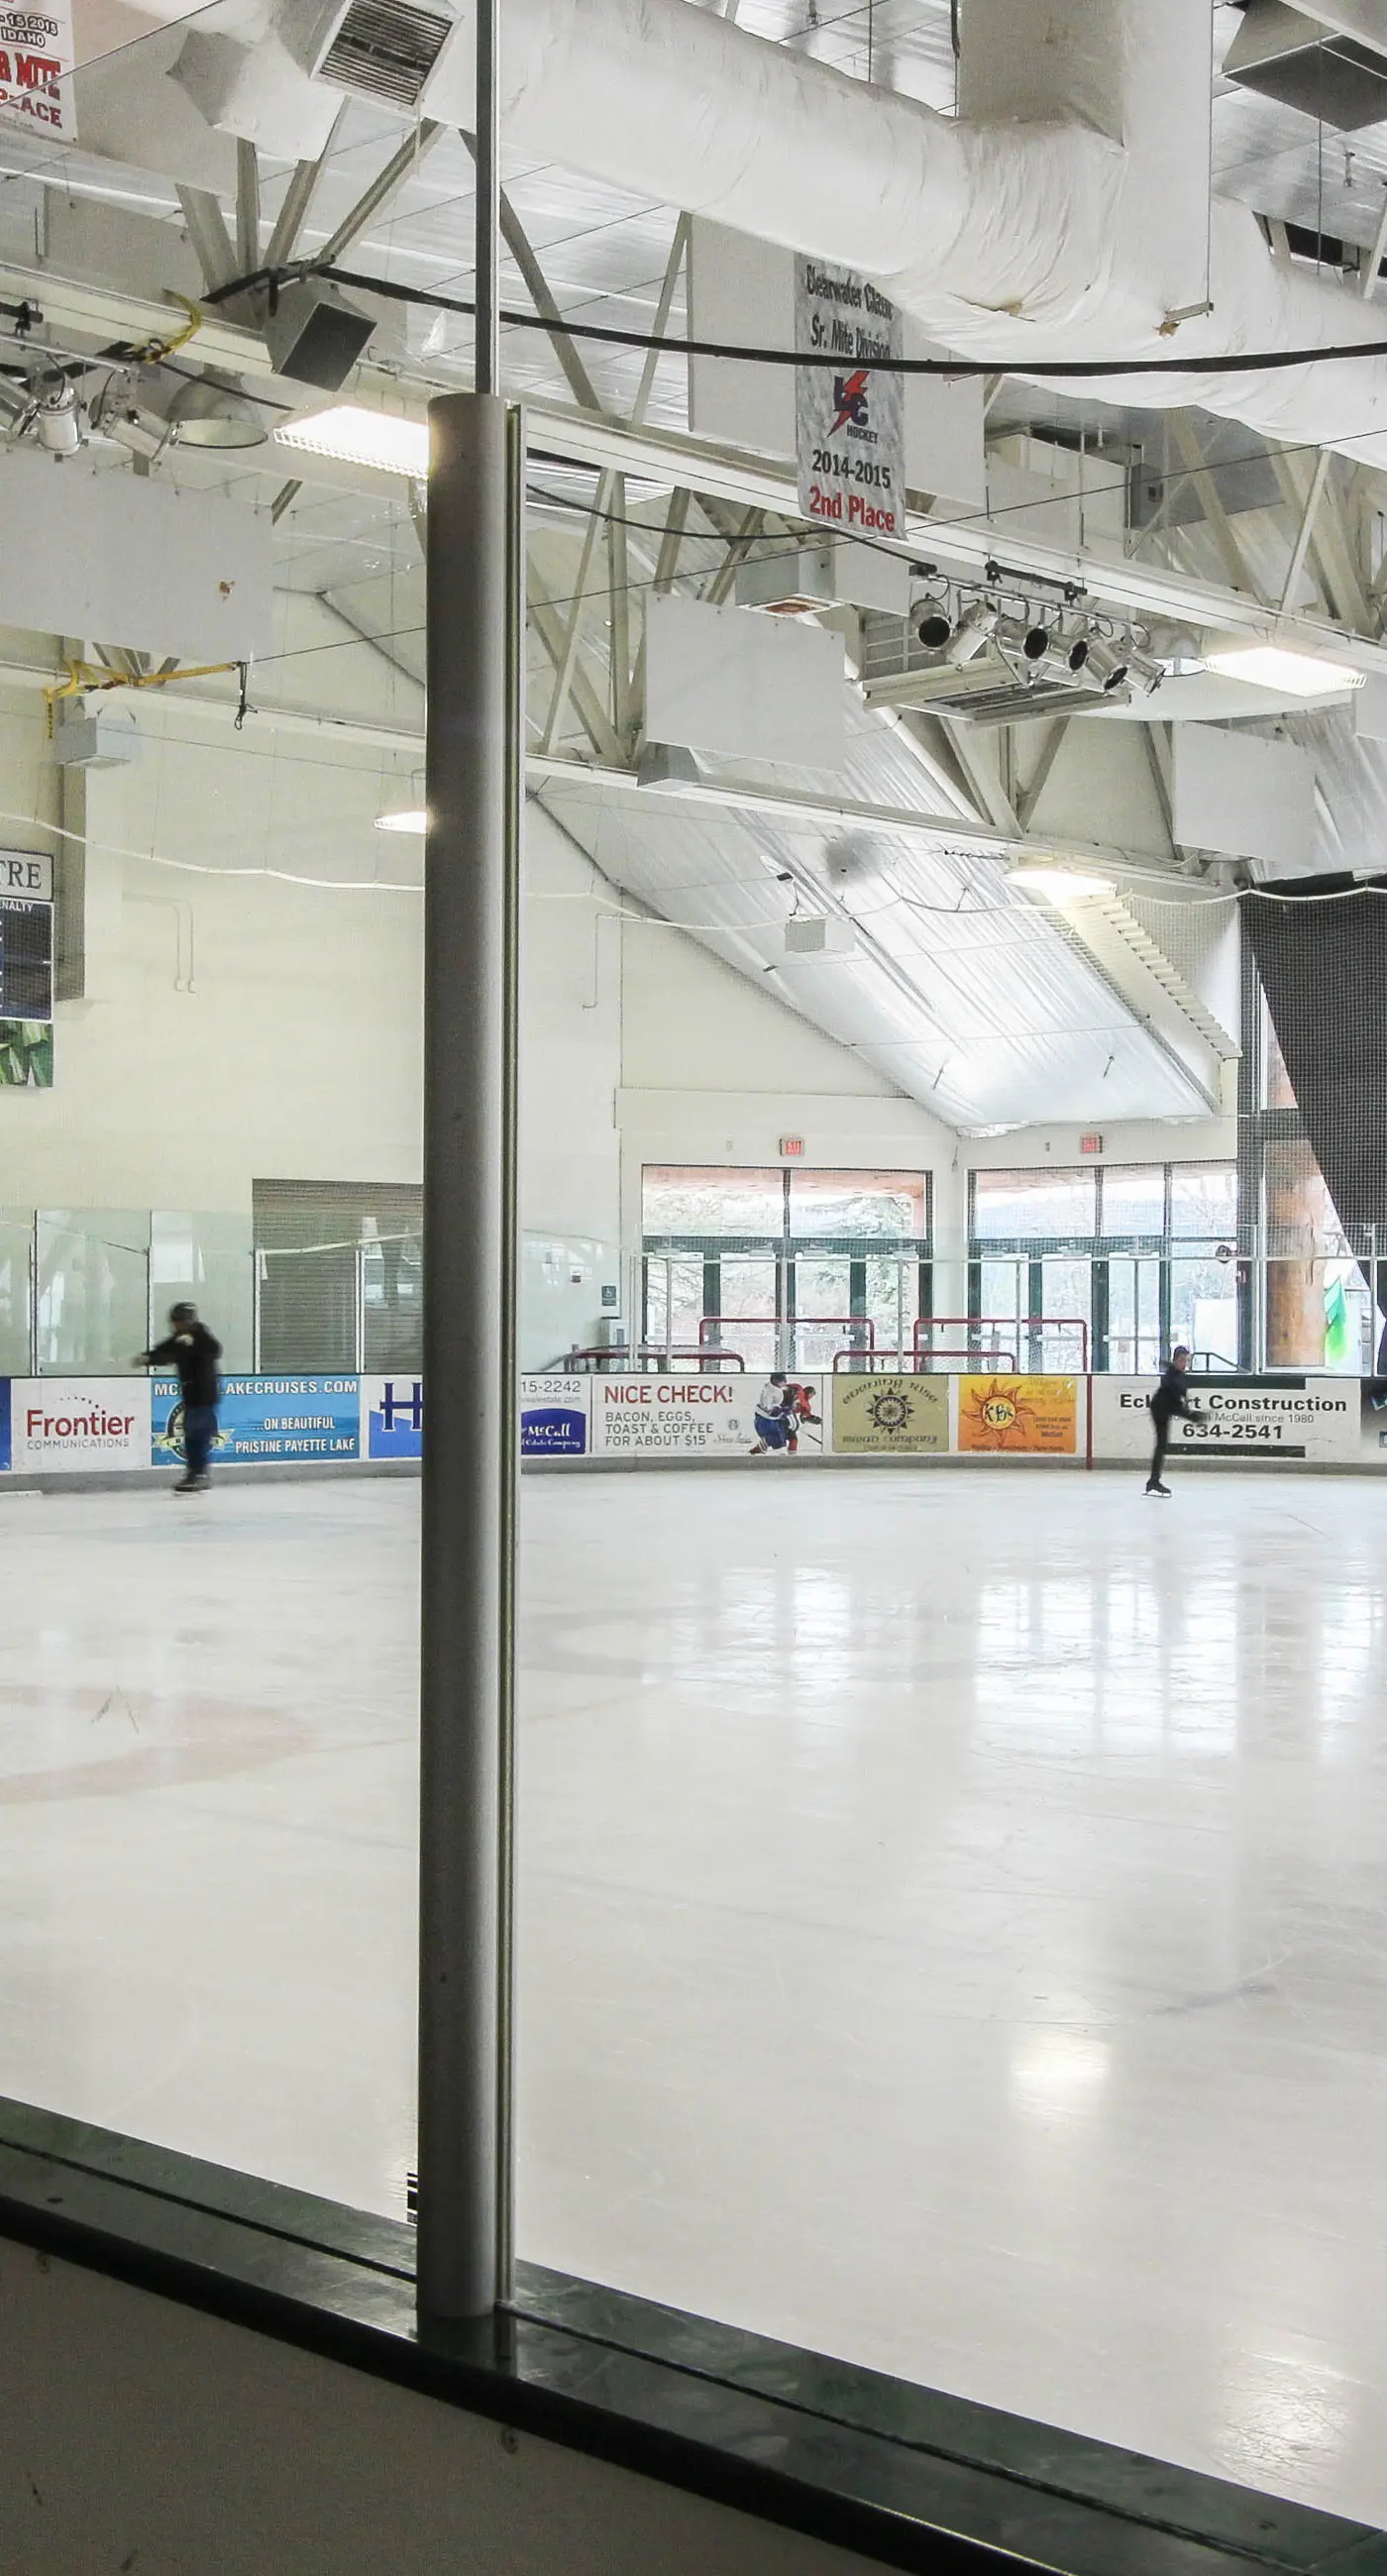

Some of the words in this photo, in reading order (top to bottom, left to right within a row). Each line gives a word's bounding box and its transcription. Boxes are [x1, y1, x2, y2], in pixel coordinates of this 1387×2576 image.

[28, 16, 57, 36] 2015
[1, 27, 46, 48] IDAHO
[811, 313, 827, 349] Sr.
[832, 319, 853, 356] Mite
[847, 424, 879, 444] HOCKEY
[812, 449, 891, 488] 2014-2015
[809, 484, 842, 519] 2nd
[848, 494, 895, 532] Place
[0, 900, 34, 912] NALTY
[604, 1385, 651, 1403] NICE
[657, 1385, 733, 1403] CHECK!
[1209, 1395, 1347, 1411] Construction
[27, 1409, 135, 1437] Frontier
[281, 1416, 335, 1430] BEAUTIFUL
[605, 1412, 654, 1423] BACON,
[658, 1412, 695, 1423] EGGS,
[1215, 1413, 1252, 1422] McCall
[1255, 1414, 1285, 1423] since
[1289, 1415, 1315, 1424] 1980
[605, 1424, 646, 1434] TOAST
[651, 1424, 659, 1434] &
[663, 1423, 714, 1434] COFFEE
[1183, 1424, 1282, 1439] 634-2541
[27, 1439, 130, 1450] COMMUNICATIONS
[235, 1440, 281, 1454] PRISTINE
[284, 1439, 327, 1451] PAYETTE
[330, 1438, 355, 1450] LAKE
[605, 1436, 630, 1447] FOR
[634, 1436, 680, 1447] ABOUT
[685, 1435, 706, 1447] $15
